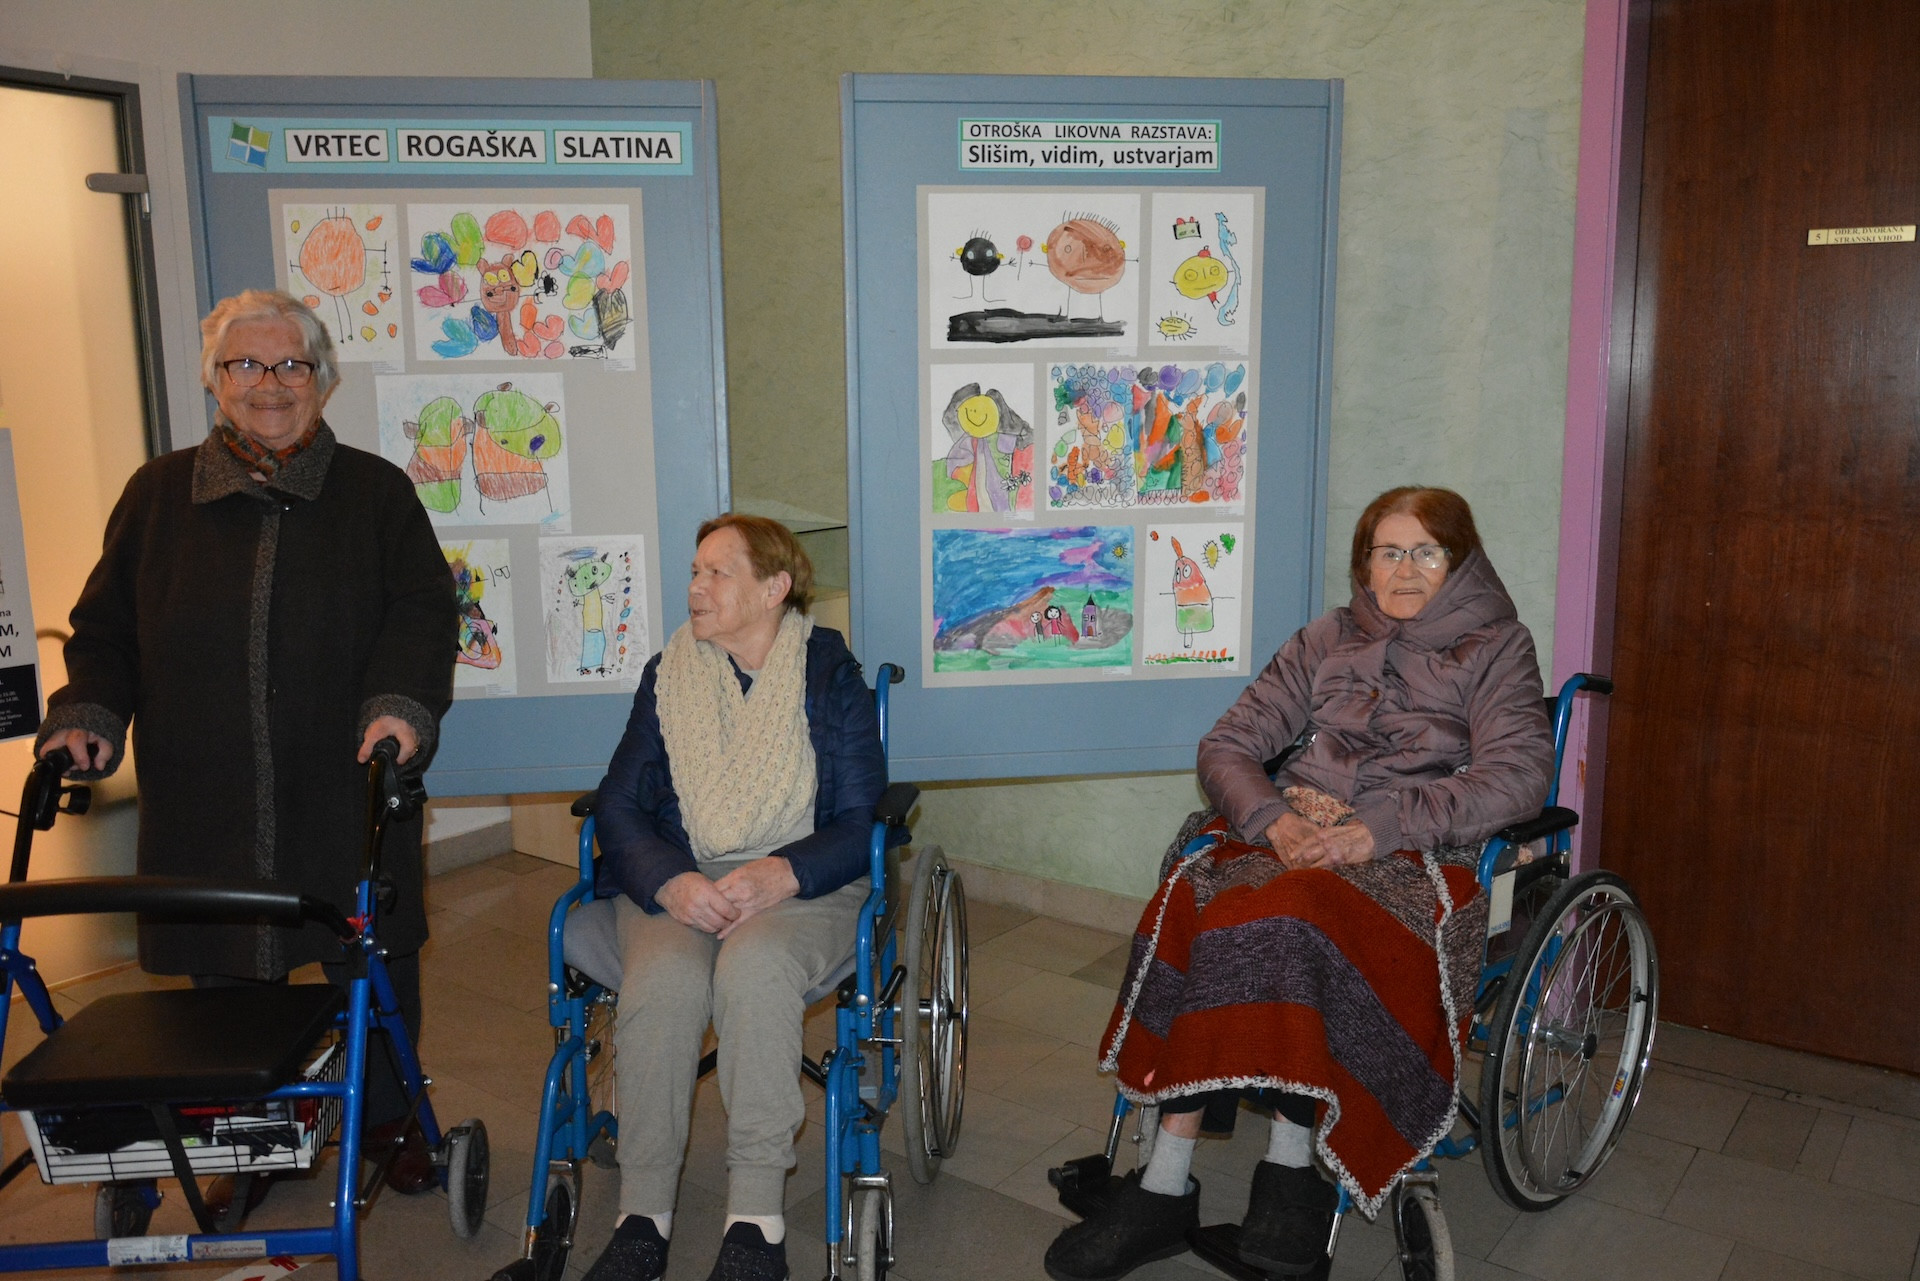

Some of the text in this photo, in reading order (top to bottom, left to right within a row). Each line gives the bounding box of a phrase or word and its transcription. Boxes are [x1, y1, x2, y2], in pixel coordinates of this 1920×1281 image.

[969, 122, 1212, 140] OTROŠKA LIKOVNA RAZSTAVA:
[293, 130, 674, 160] VRTEC ROGAŠKA SLATINA
[968, 145, 1213, 168] Slišim, vidim, ustvarjam
[1815, 233, 1822, 241] 5
